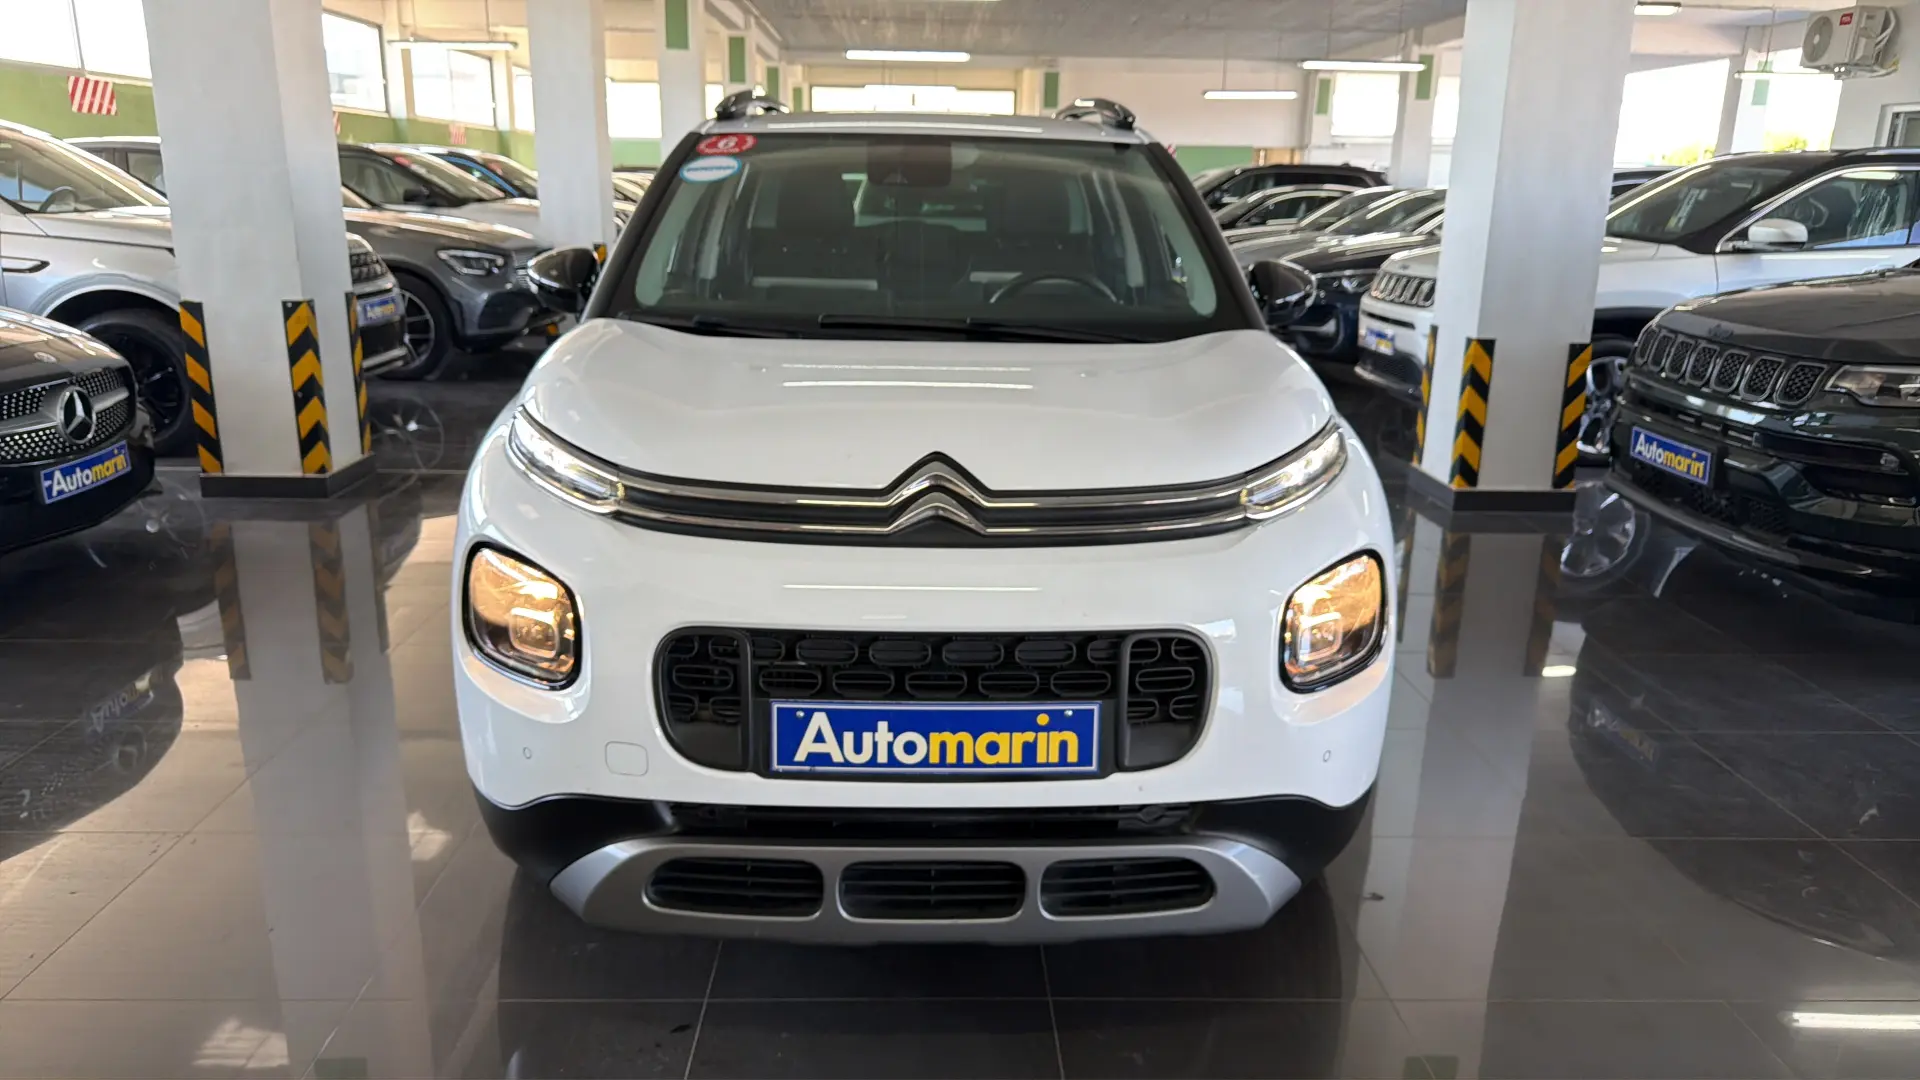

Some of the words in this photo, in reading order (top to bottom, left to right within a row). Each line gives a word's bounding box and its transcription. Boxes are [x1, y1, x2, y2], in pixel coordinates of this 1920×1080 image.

[52, 448, 127, 497] Automarin
[1635, 433, 1705, 478] Automarin
[794, 711, 1079, 765] Automarin
